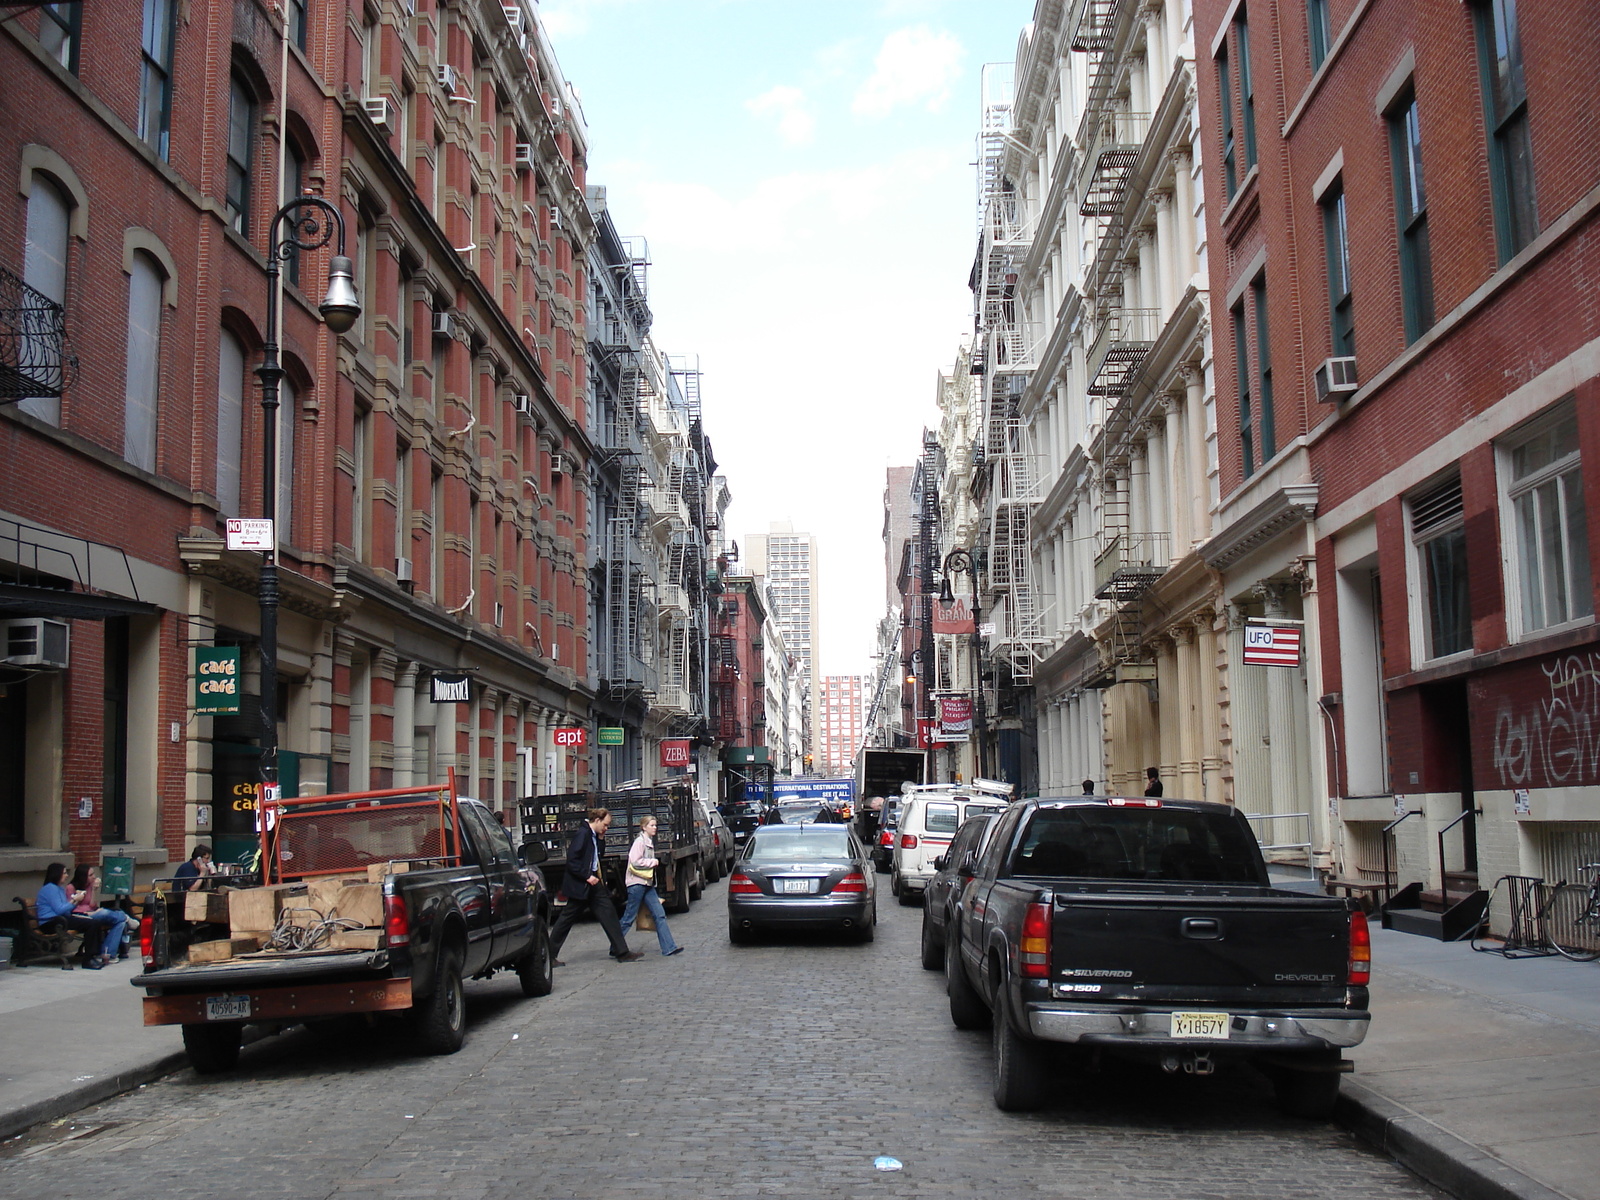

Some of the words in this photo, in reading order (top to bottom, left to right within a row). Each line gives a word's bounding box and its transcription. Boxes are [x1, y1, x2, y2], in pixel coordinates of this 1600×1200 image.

[229, 521, 241, 532] NO
[938, 609, 974, 621] GRAND
[1249, 632, 1272, 644] UFO
[200, 659, 235, 675] café
[200, 678, 235, 694] café
[434, 677, 469, 701] MODERNICA
[557, 729, 582, 746] apt
[665, 747, 687, 761] ZEBA
[233, 783, 261, 795] caf
[1073, 969, 1133, 977] SILVERADO
[1074, 984, 1101, 992] 1500
